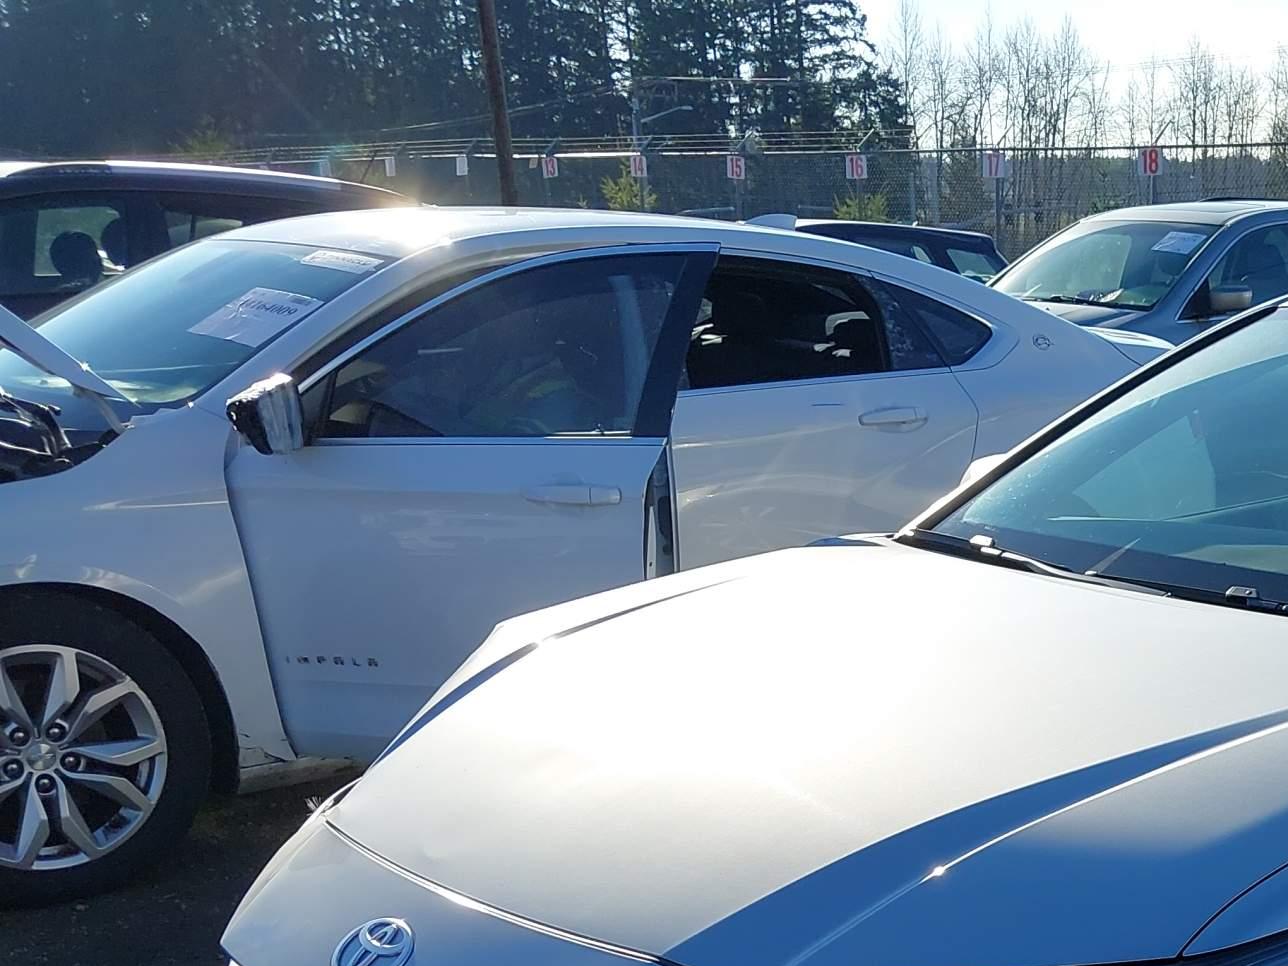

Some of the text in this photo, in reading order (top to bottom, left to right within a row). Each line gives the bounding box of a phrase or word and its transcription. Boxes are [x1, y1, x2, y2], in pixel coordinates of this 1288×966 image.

[545, 158, 556, 177] 13
[634, 157, 645, 176] 14
[730, 156, 743, 178] 15
[849, 156, 864, 178] 16
[988, 153, 1000, 177] 17
[1141, 149, 1159, 175] 18
[285, 655, 379, 667] IMPALA
